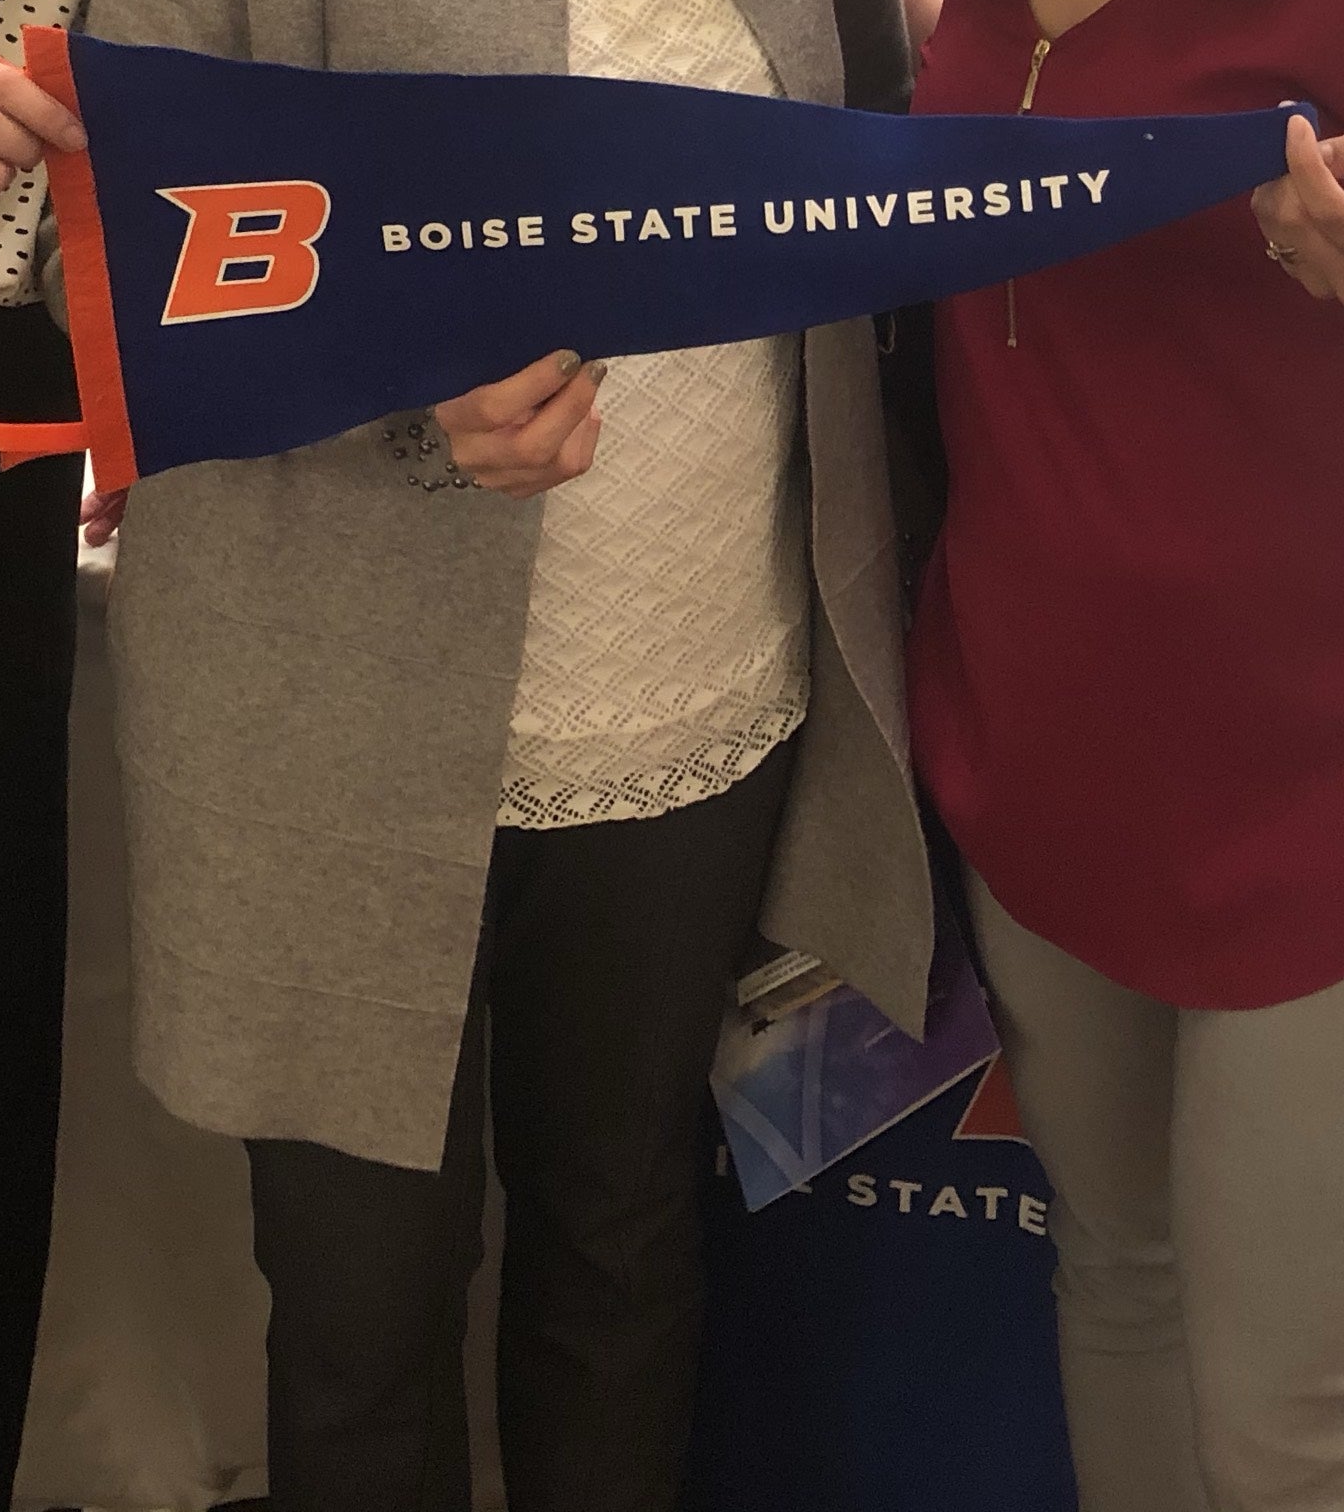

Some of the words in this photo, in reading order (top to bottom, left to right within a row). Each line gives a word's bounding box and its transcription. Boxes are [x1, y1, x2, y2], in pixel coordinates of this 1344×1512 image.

[154, 179, 332, 326] B
[381, 215, 546, 253] BOISE
[571, 202, 738, 245] STATE
[763, 168, 1111, 235] UNIVERSITY
[846, 1173, 1048, 1237] STATE
